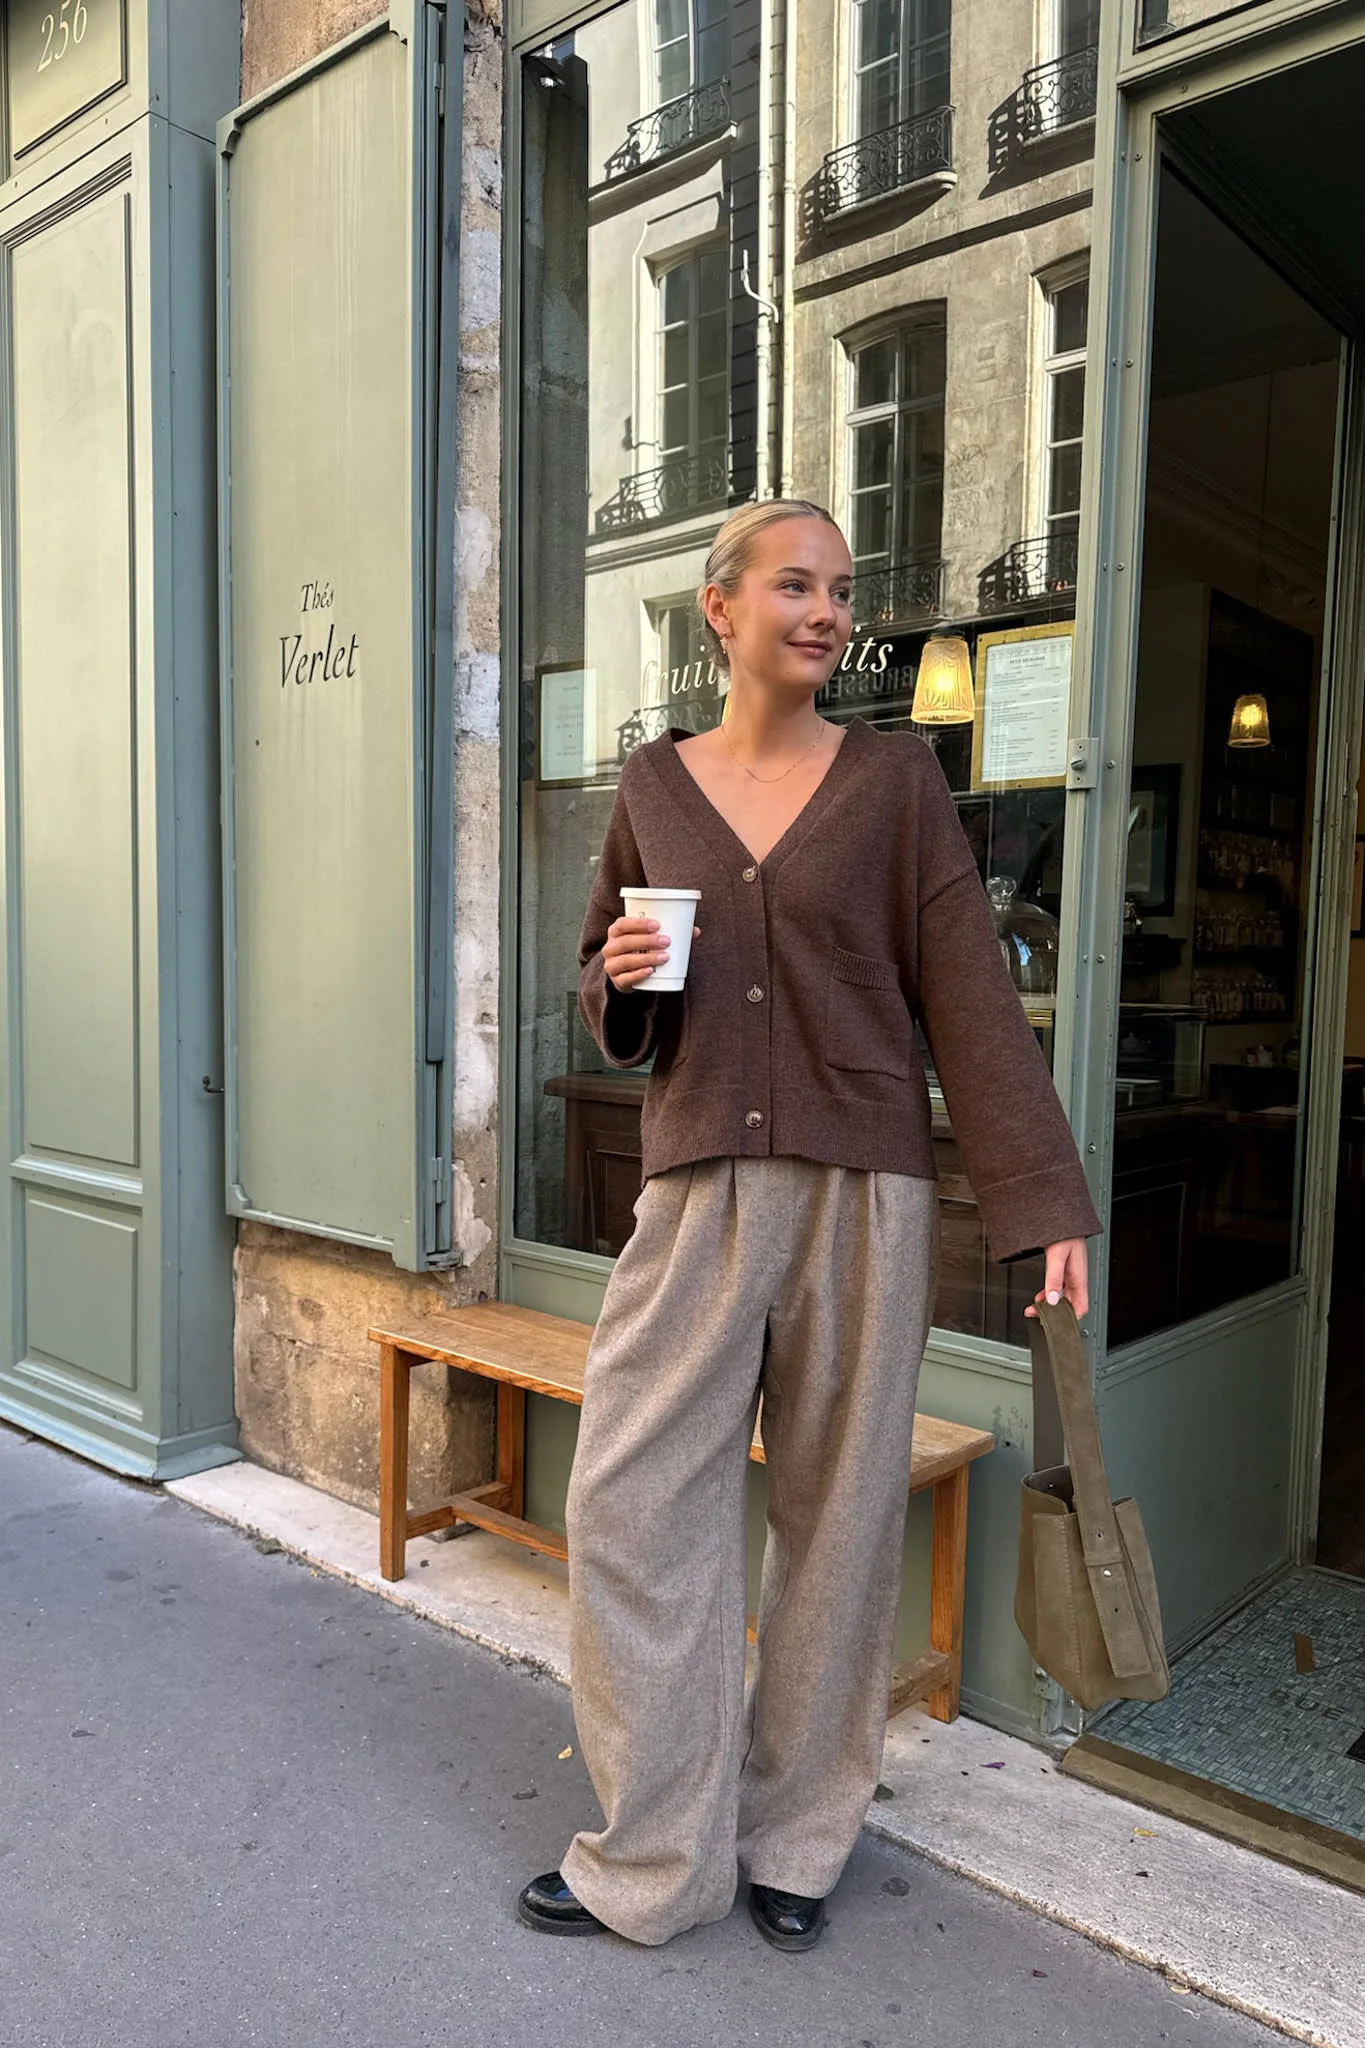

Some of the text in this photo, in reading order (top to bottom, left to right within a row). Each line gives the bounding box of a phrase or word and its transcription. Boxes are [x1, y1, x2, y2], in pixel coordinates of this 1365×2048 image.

[37, 0, 87, 73] 256
[301, 580, 334, 612] Thés
[280, 624, 359, 688] Verlet
